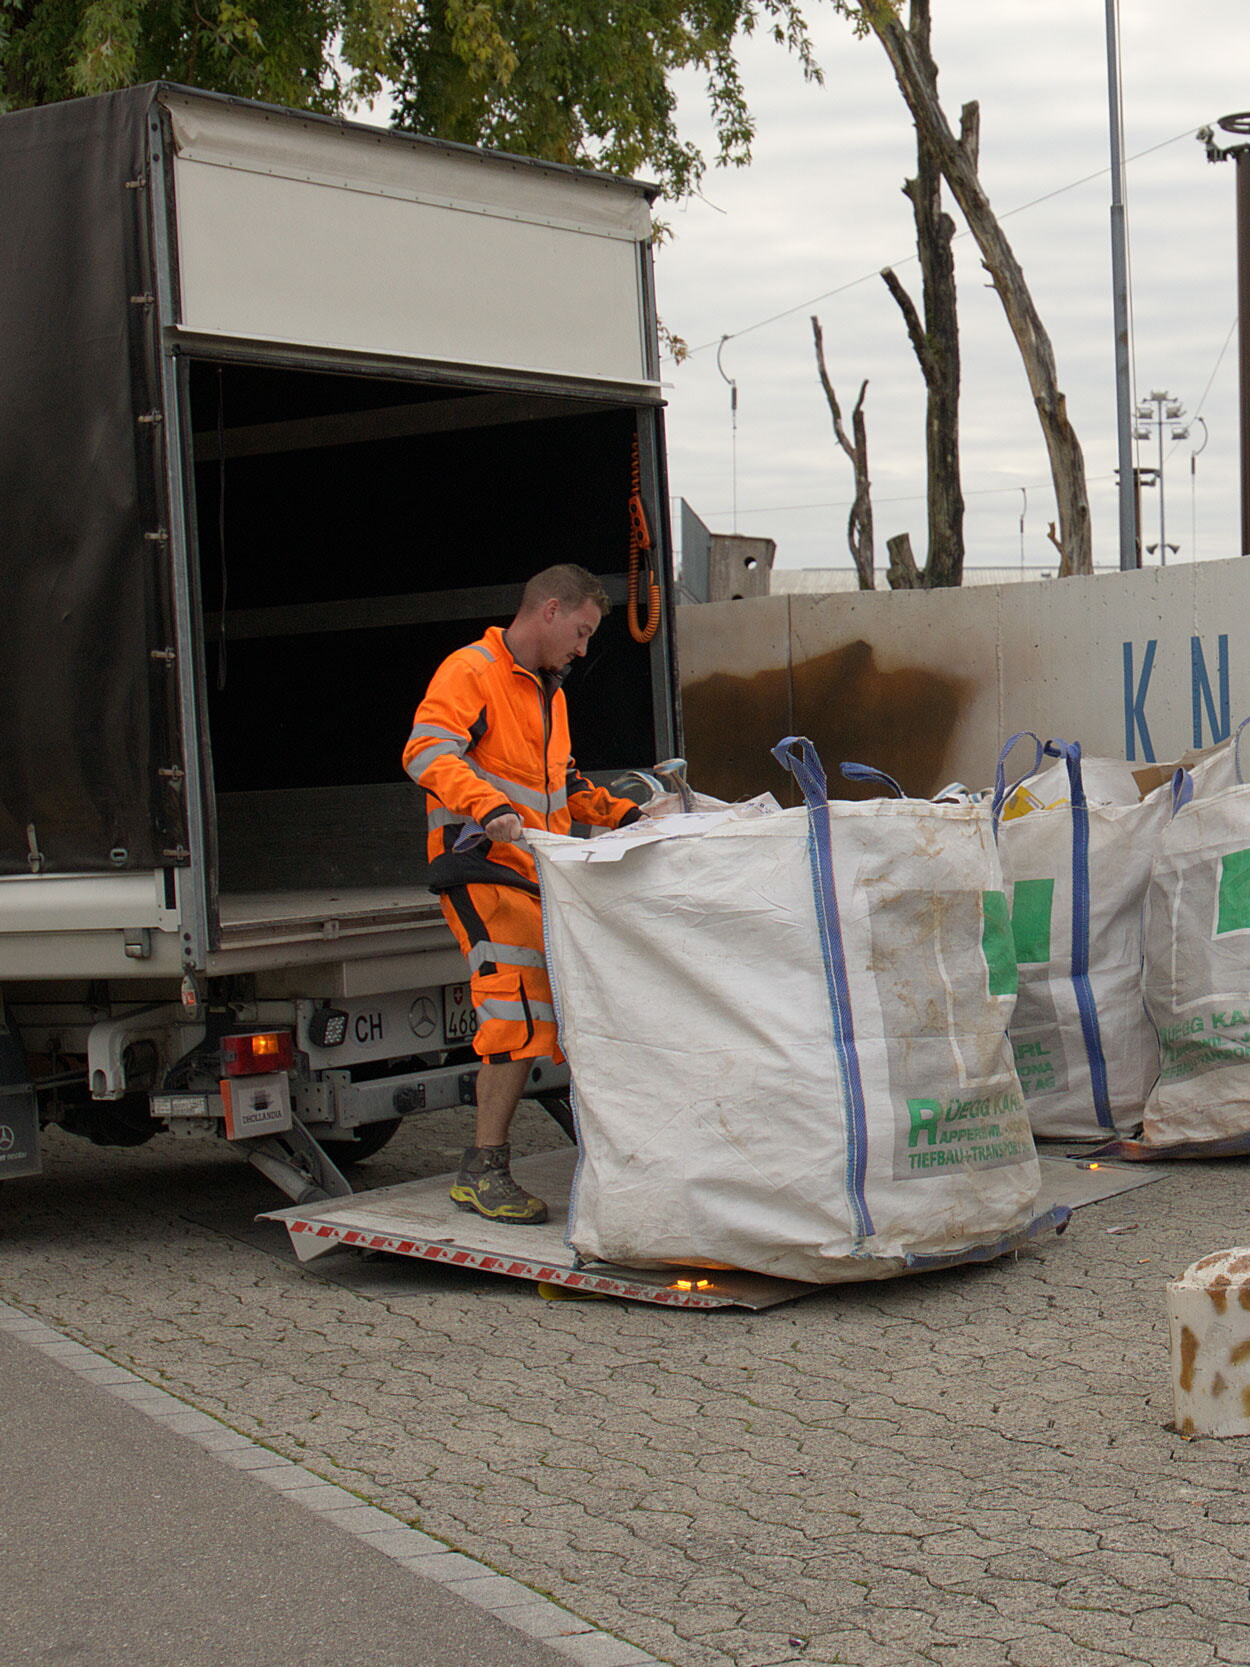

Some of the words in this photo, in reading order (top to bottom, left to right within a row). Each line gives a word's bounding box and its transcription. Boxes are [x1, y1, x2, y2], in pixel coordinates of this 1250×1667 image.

[355, 1013, 383, 1042] CH
[448, 1010, 477, 1036] 468
[242, 1110, 282, 1124] DHOLLANDIA
